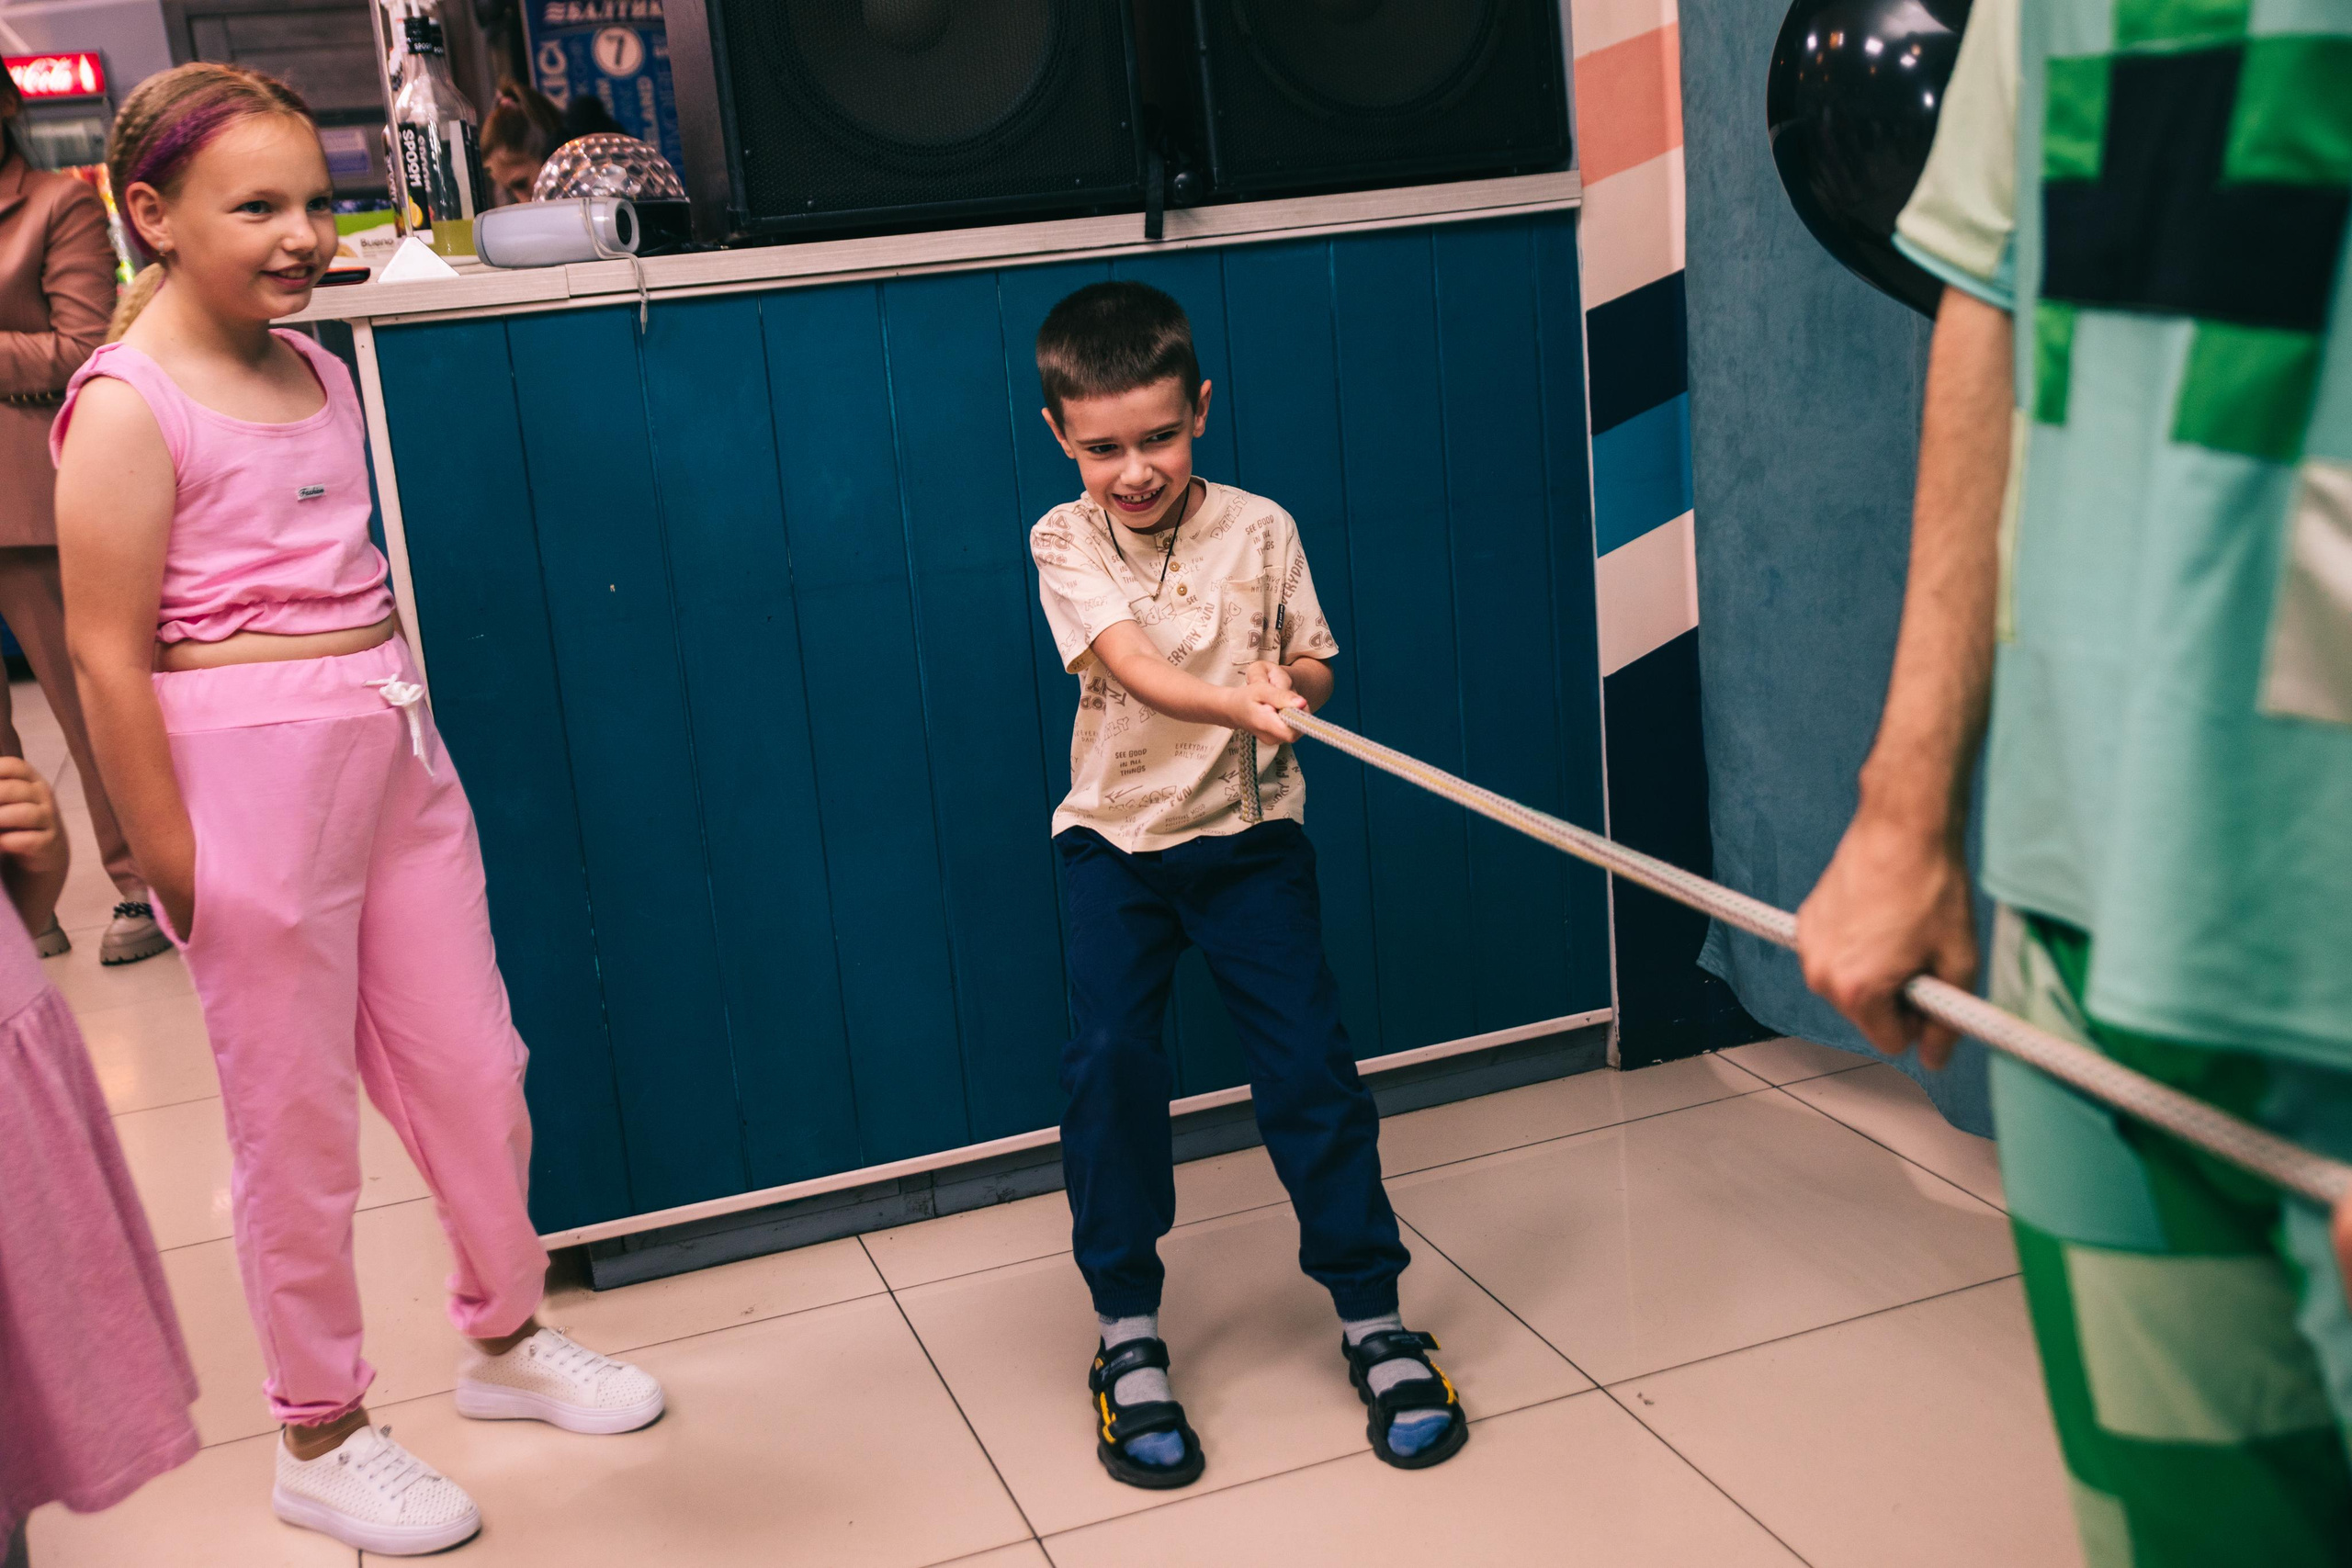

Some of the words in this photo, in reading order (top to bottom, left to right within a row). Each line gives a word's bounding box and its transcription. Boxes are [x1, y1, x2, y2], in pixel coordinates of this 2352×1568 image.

[605, 34, 625, 67] 7
[360, 238, 394, 248] Bueno
[1210, 495, 1248, 540] DAILY
[1245, 525, 1257, 535] SEE
[1257, 514, 1274, 529] GOOD
[1252, 536, 1261, 545] IN
[1256, 541, 1275, 557] THGS
[1111, 554, 1121, 563] SE
[1281, 549, 1305, 605] VERYDAY
[1167, 628, 1202, 667] ERYDAY
[1175, 742, 1208, 752] EVERYDAY
[1128, 748, 1148, 758] GOOD
[1174, 751, 1194, 760] DAILY
[1121, 765, 1146, 776] THINGS
